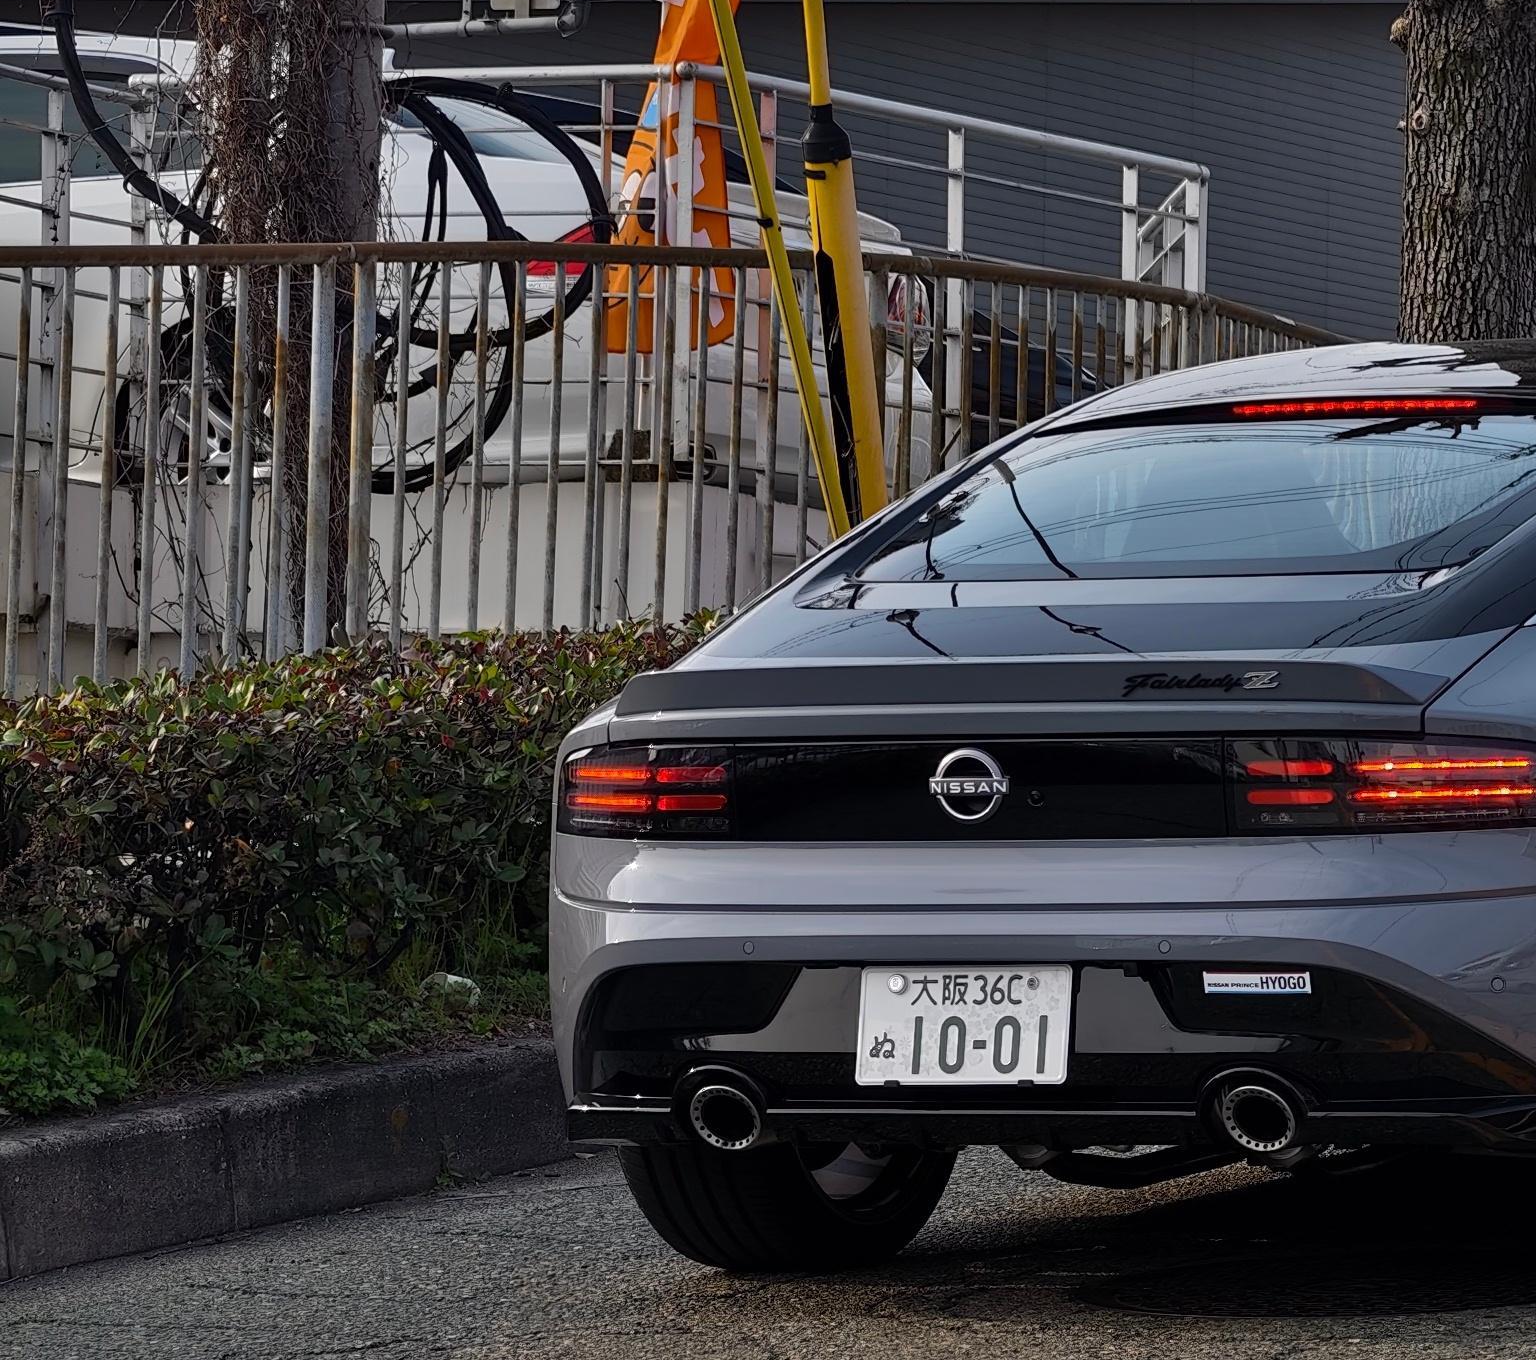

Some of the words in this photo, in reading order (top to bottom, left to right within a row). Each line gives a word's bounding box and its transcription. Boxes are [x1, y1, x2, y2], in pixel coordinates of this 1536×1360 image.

[930, 781, 1007, 794] NISSAN
[911, 974, 968, 1006] 大阪
[972, 974, 1023, 1006] 36C
[1260, 975, 1307, 990] HYOGO
[869, 1031, 896, 1059] ぬ
[911, 1015, 1049, 1075] 10-01
